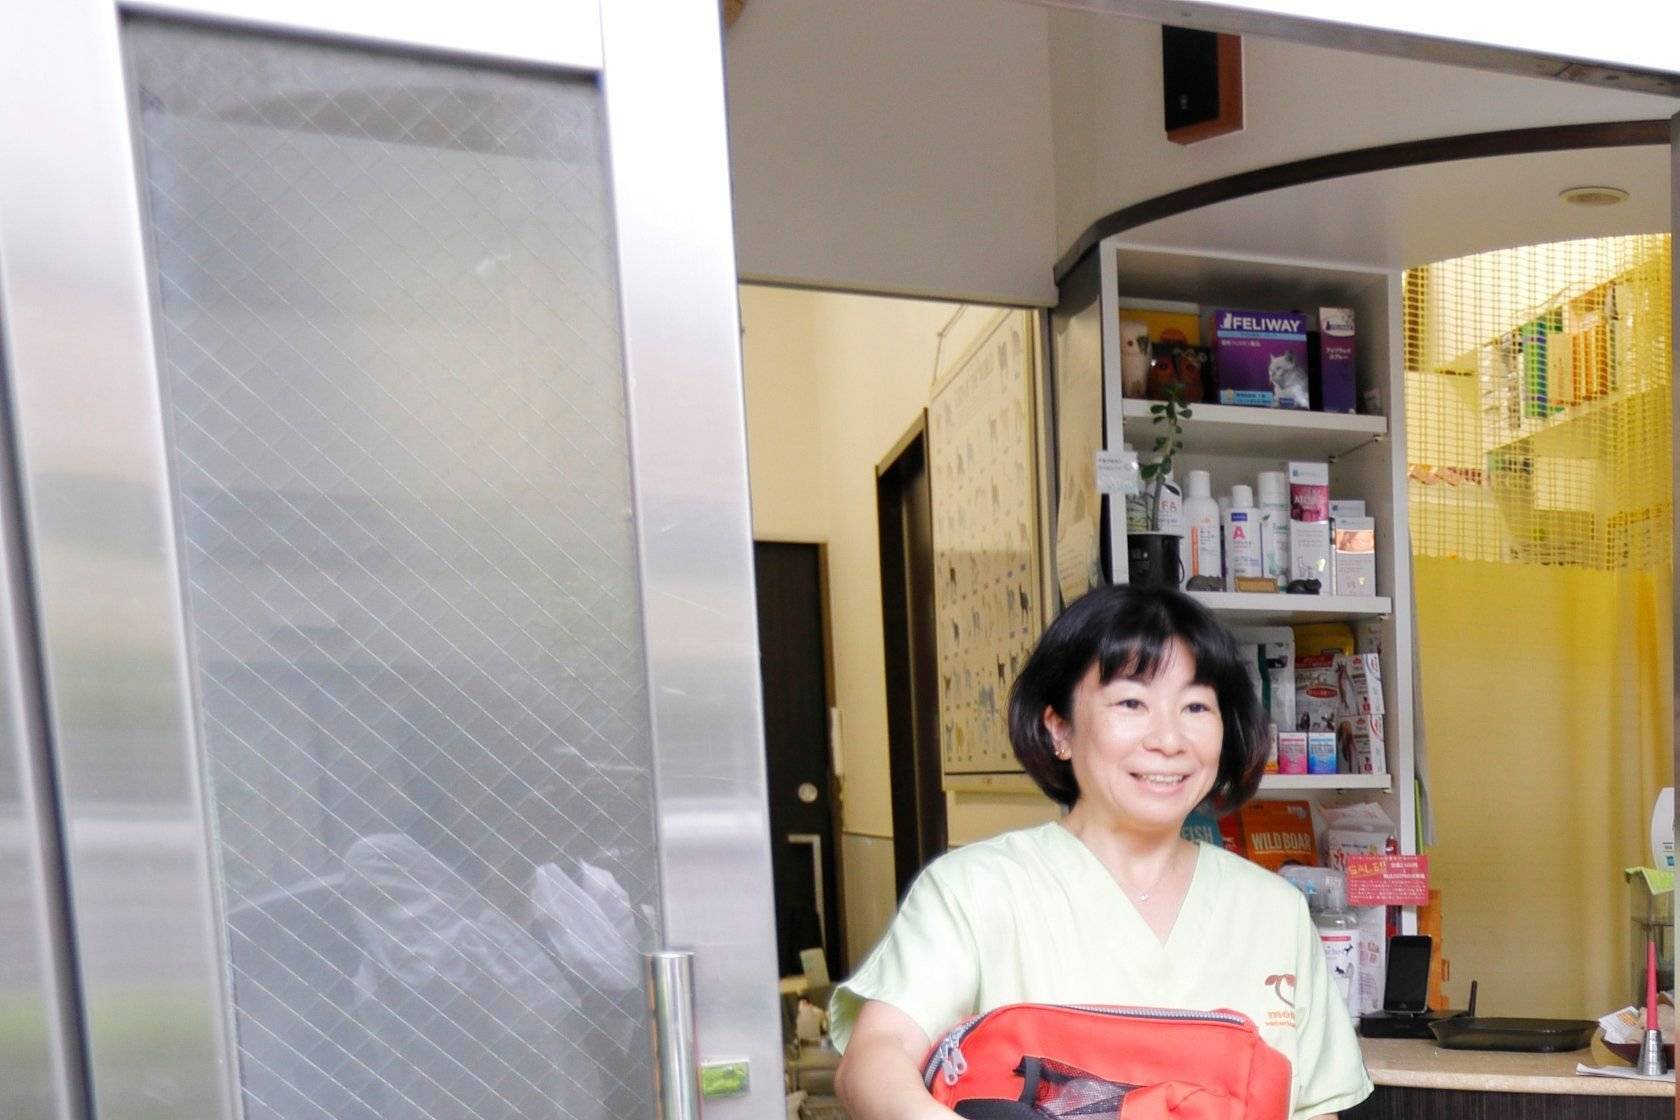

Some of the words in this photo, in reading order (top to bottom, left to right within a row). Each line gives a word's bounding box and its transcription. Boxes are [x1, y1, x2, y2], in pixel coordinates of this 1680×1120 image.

[1232, 316, 1301, 332] FELIWAY
[1251, 832, 1281, 850] WILD
[1283, 832, 1312, 851] BOAR
